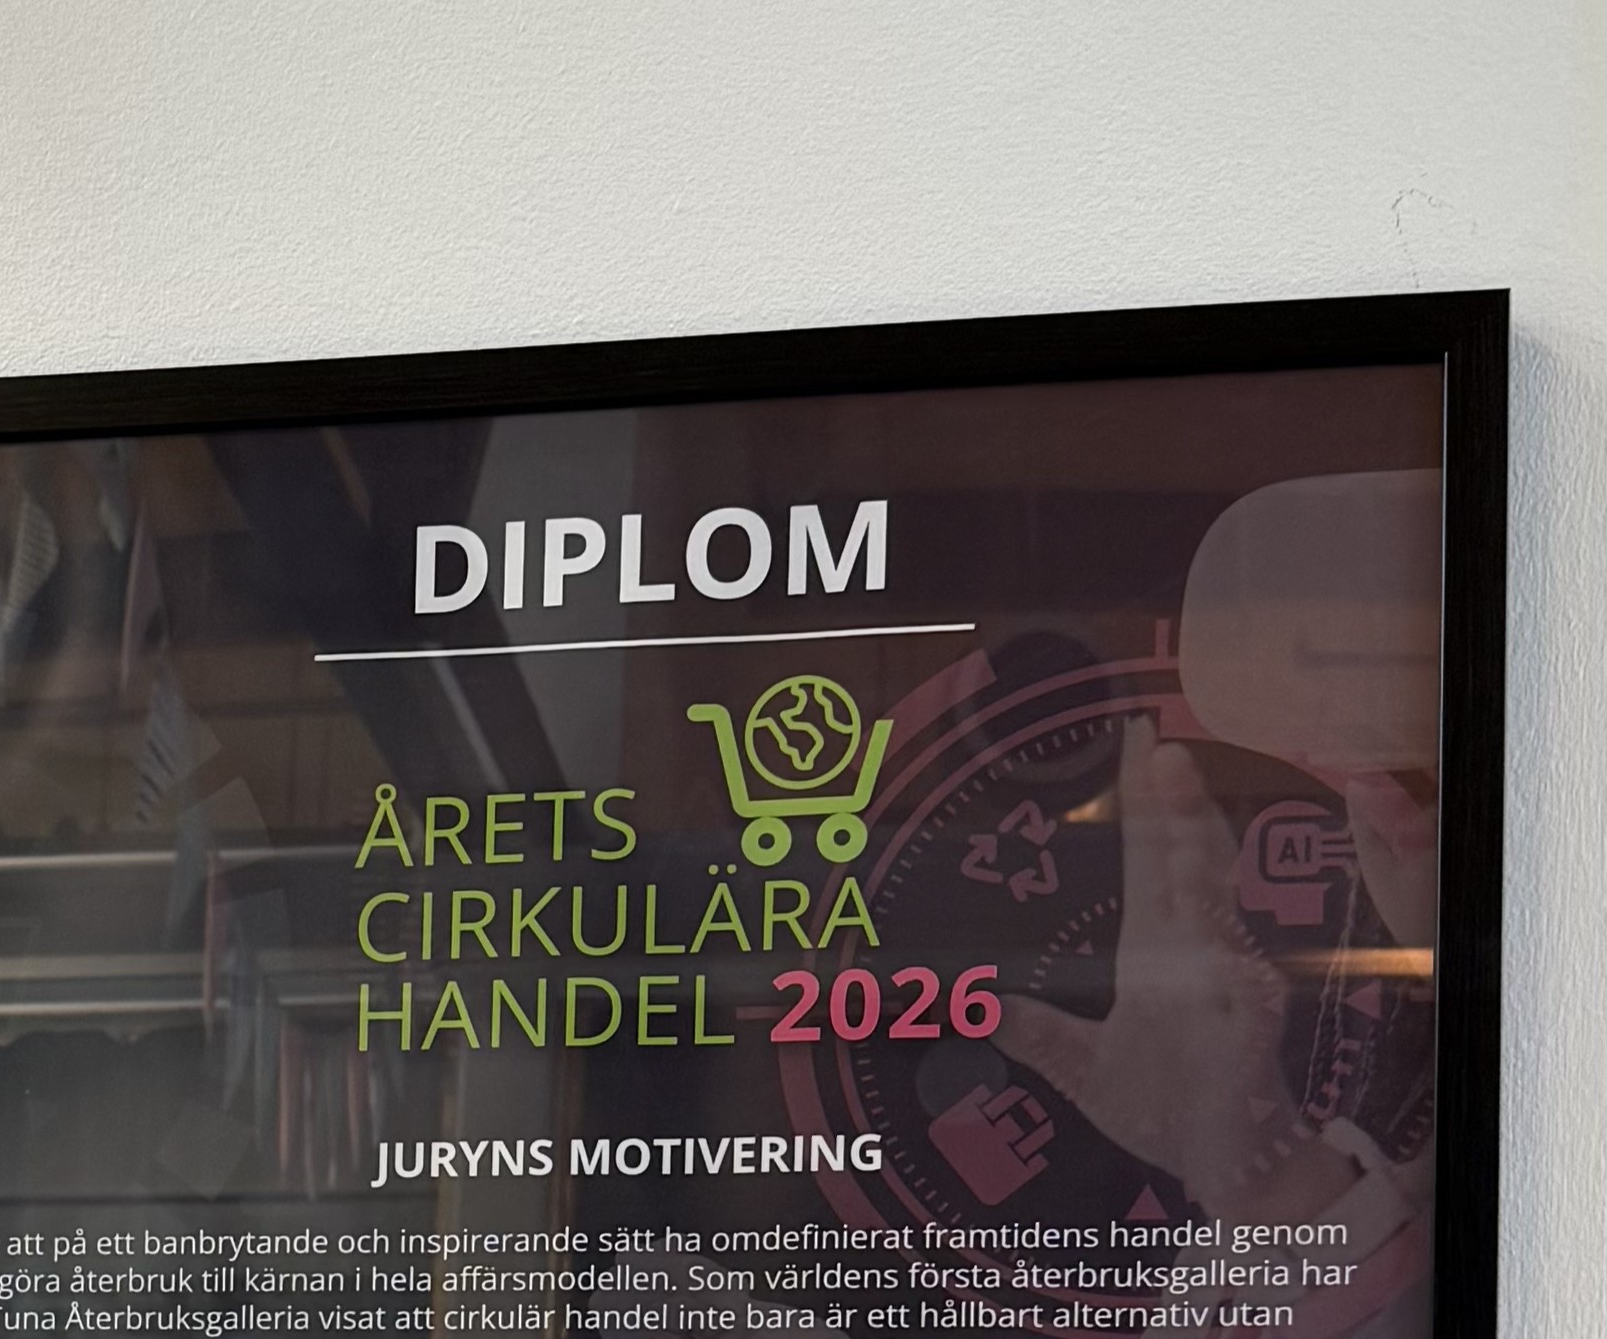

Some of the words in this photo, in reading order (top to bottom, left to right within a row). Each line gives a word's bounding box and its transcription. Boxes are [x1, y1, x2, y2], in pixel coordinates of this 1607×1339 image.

[414, 500, 888, 614] DIPLOM
[354, 784, 637, 868] ÅRETS
[1277, 835, 1312, 864] AI
[357, 864, 880, 963] CIRKULÄRA
[357, 974, 735, 1053] HANDEL
[769, 965, 1002, 1043] 2026
[370, 1139, 554, 1188] JURYNS
[569, 1132, 884, 1176] MOTIVERING
[5, 1231, 46, 1257] att
[52, 1226, 88, 1264] på
[95, 1231, 137, 1257] ett
[143, 1226, 330, 1264] banbrytande
[336, 1226, 391, 1255] och
[399, 1224, 590, 1262] inspirerande
[597, 1225, 657, 1254] sätt
[664, 1224, 702, 1254] ha
[710, 1221, 916, 1254] omdefinierat
[921, 1220, 1101, 1251] framtidens
[1109, 1217, 1222, 1249] handel
[1229, 1221, 1349, 1255] genom
[68, 1264, 195, 1295] återbruk
[200, 1265, 236, 1294] till
[244, 1265, 346, 1294] kärnan
[354, 1265, 362, 1293] i
[370, 1264, 433, 1293] hela
[440, 1262, 679, 1293] affärsmodellen.
[686, 1264, 756, 1293] Som
[763, 1260, 900, 1292] världens
[906, 1260, 1002, 1290] första
[1010, 1257, 1291, 1296] återbruksgalleria
[1301, 1256, 1359, 1287] har
[63, 1299, 311, 1339] Återbruksgalleria
[317, 1303, 388, 1332] visat
[393, 1305, 437, 1332] att
[442, 1302, 557, 1332] cirkulär
[564, 1301, 669, 1332] handel
[678, 1302, 737, 1332] inte
[745, 1301, 816, 1331] bara
[824, 1301, 860, 1330] är
[865, 1303, 912, 1330] ett
[919, 1297, 1045, 1330] hållbart
[1051, 1299, 1211, 1330] alternativ
[1218, 1301, 1294, 1328] utan
